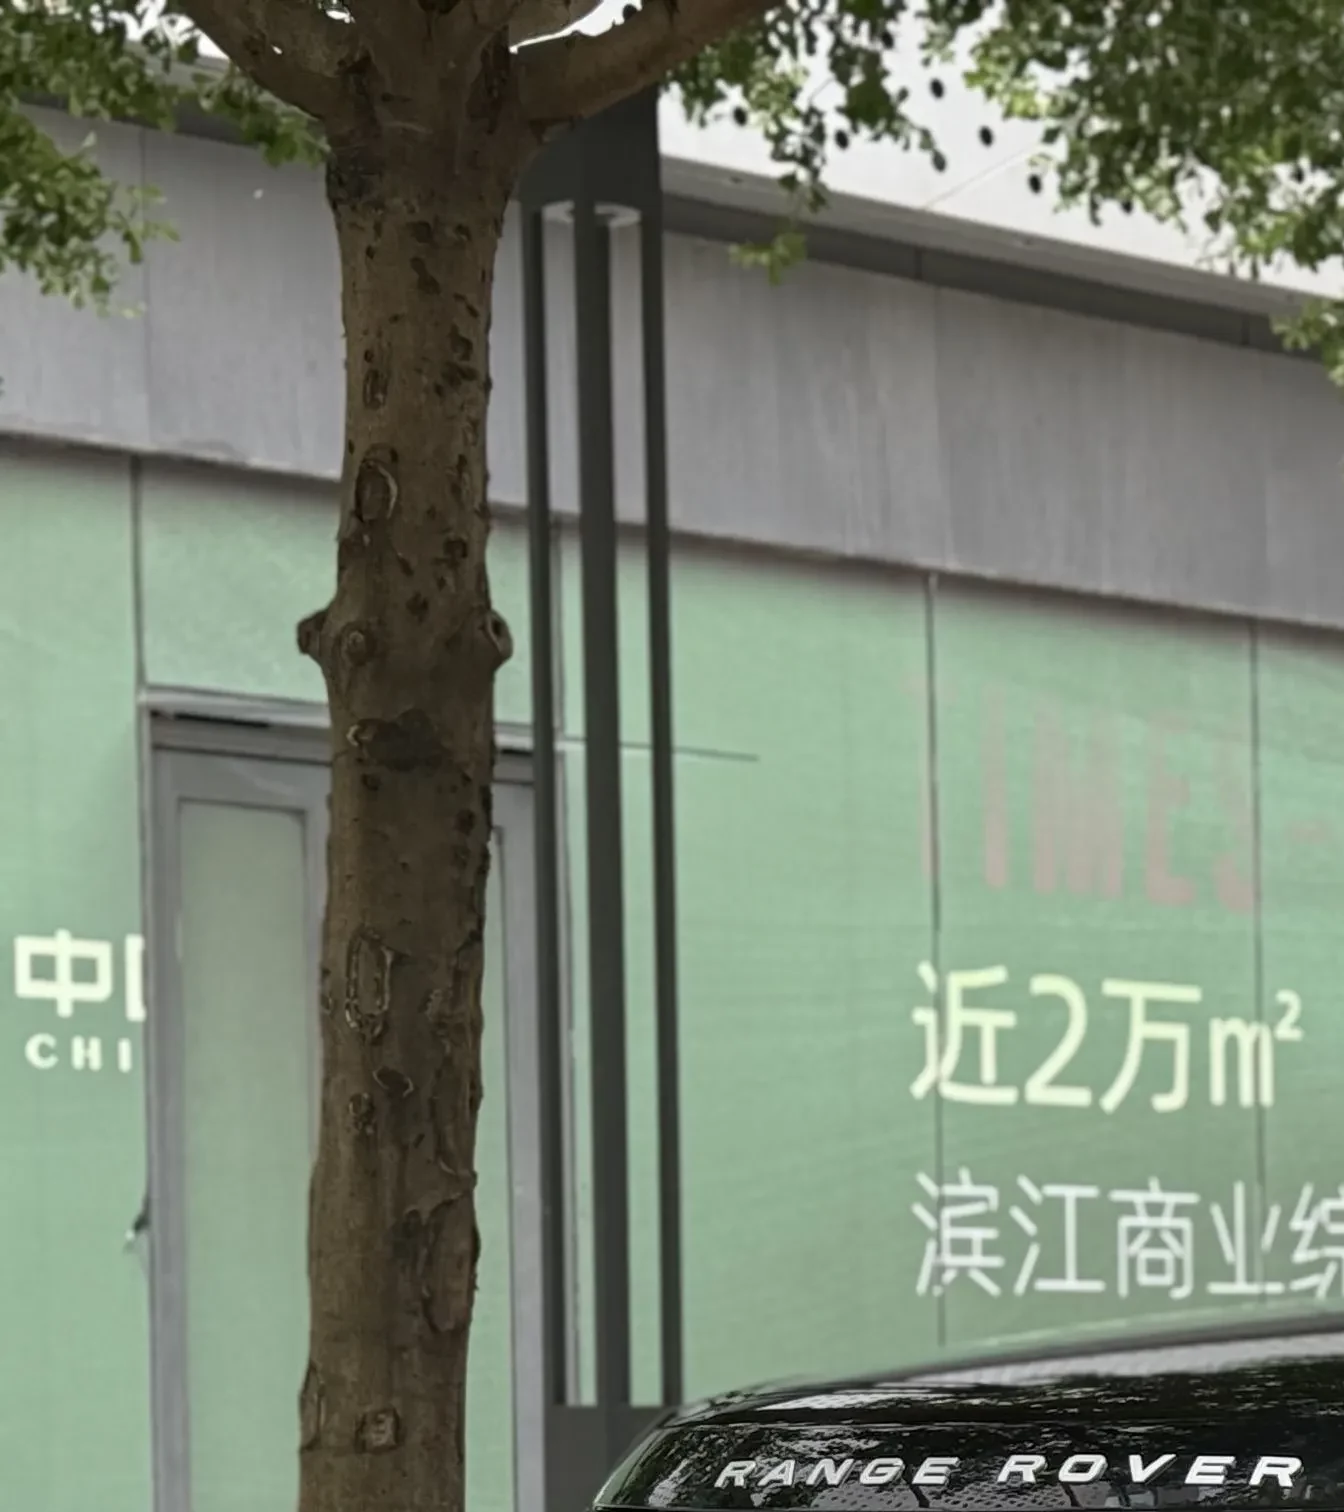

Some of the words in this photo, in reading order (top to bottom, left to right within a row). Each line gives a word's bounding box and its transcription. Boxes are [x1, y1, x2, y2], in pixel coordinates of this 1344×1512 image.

[14, 928, 147, 1022] 中
[713, 1456, 962, 1488] RANGE
[996, 1453, 1304, 1488] ROVER
